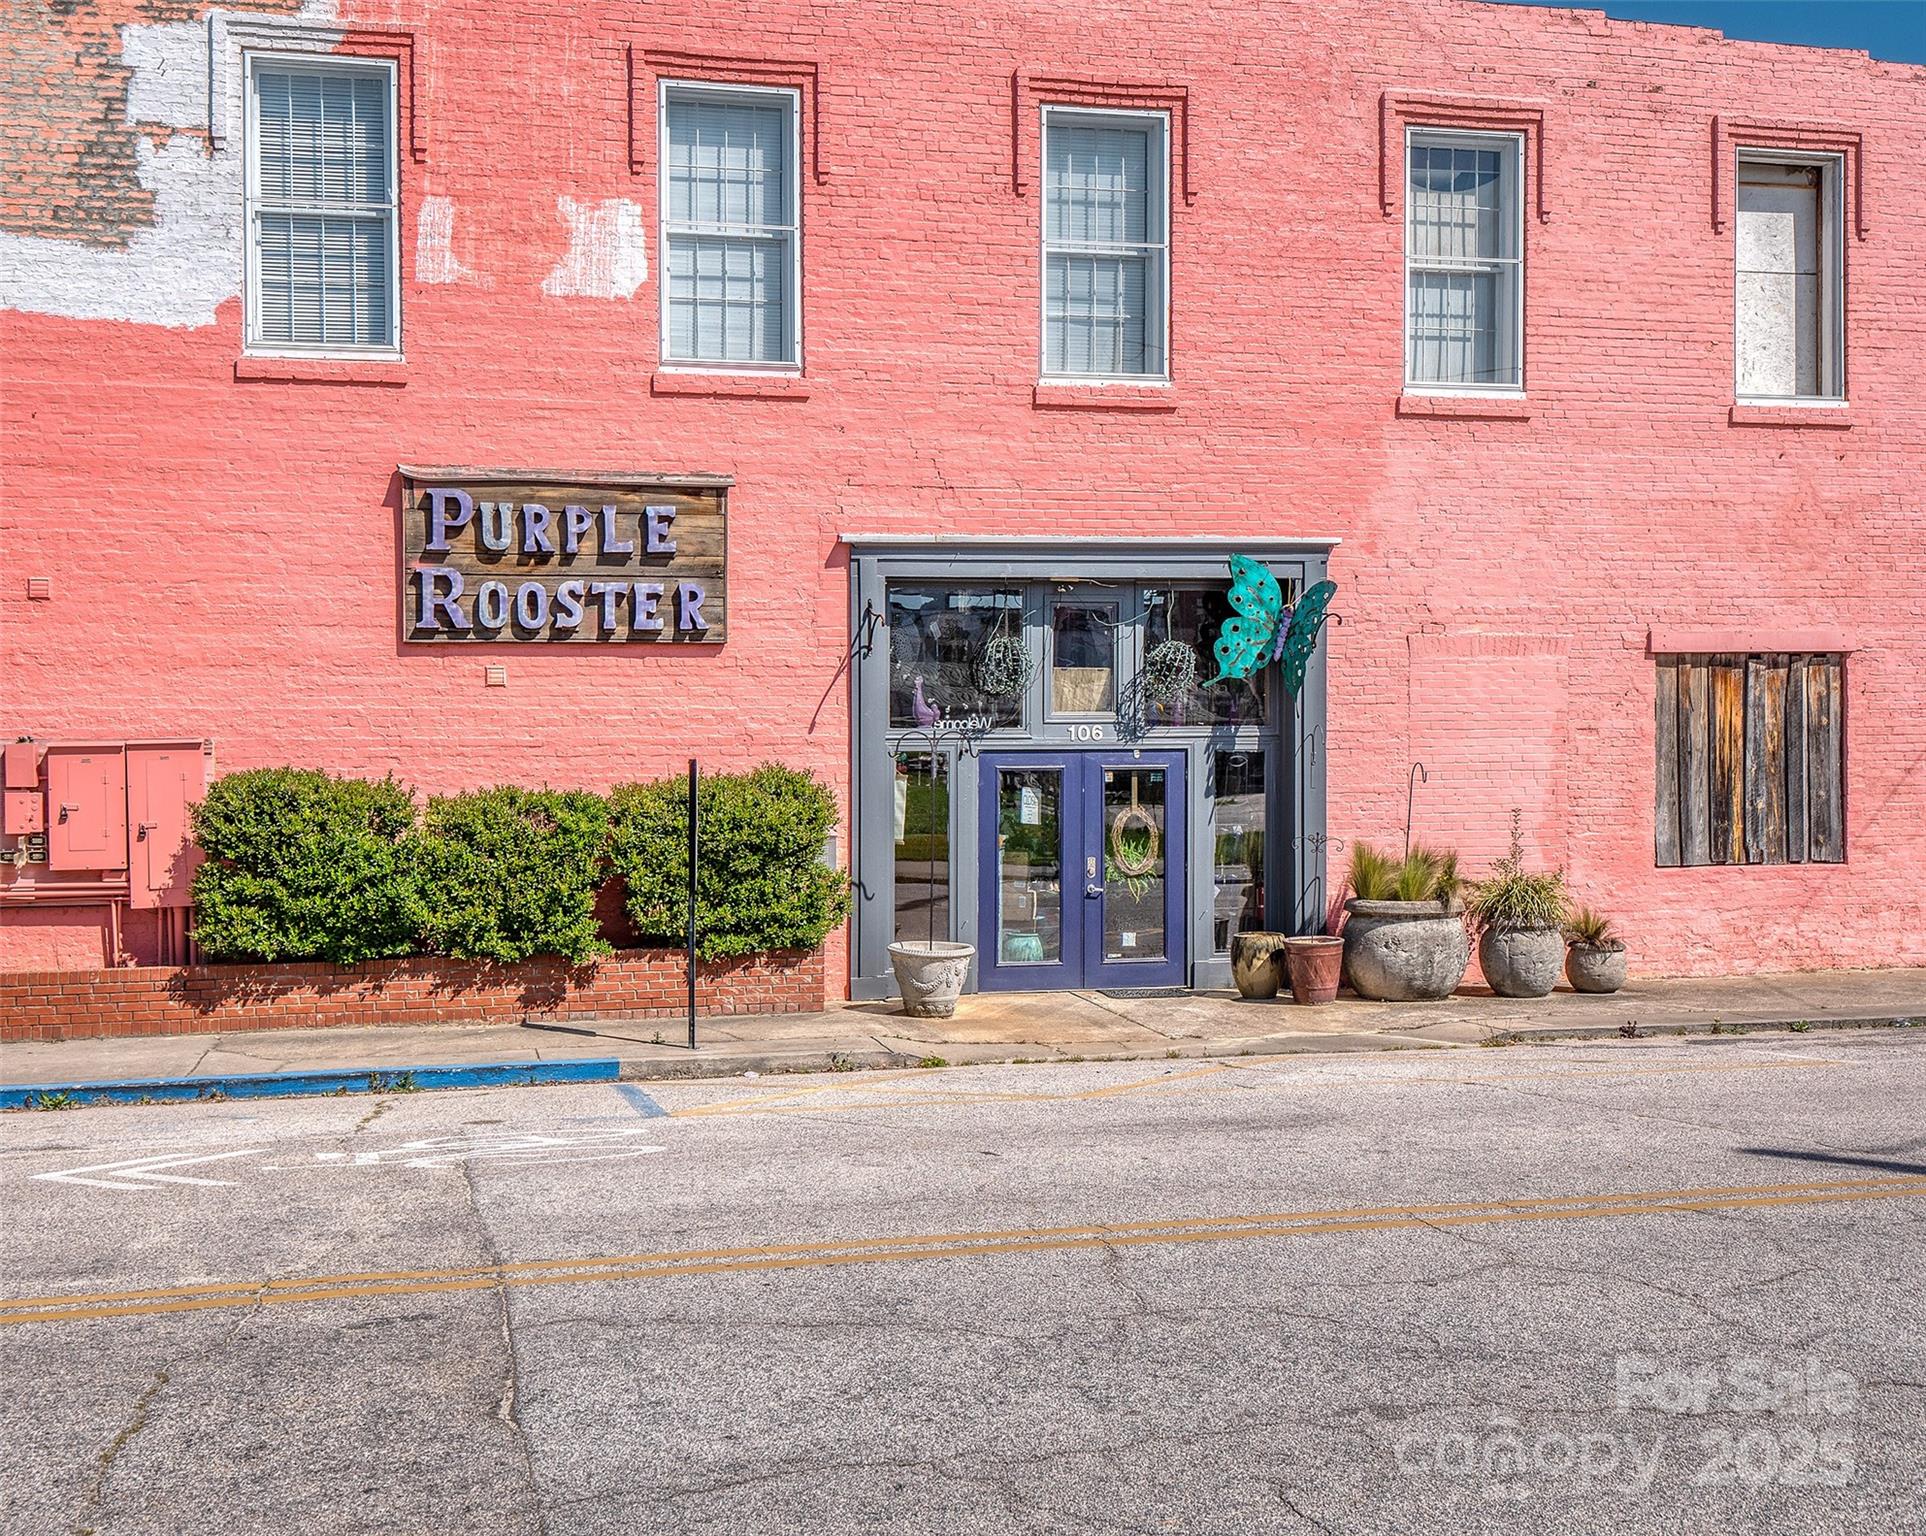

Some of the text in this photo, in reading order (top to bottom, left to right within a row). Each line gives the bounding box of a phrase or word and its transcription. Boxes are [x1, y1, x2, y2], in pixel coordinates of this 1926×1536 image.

[425, 488, 677, 553] PURPLE
[416, 567, 710, 630] ROOSTER
[1066, 726, 1103, 741] 106
